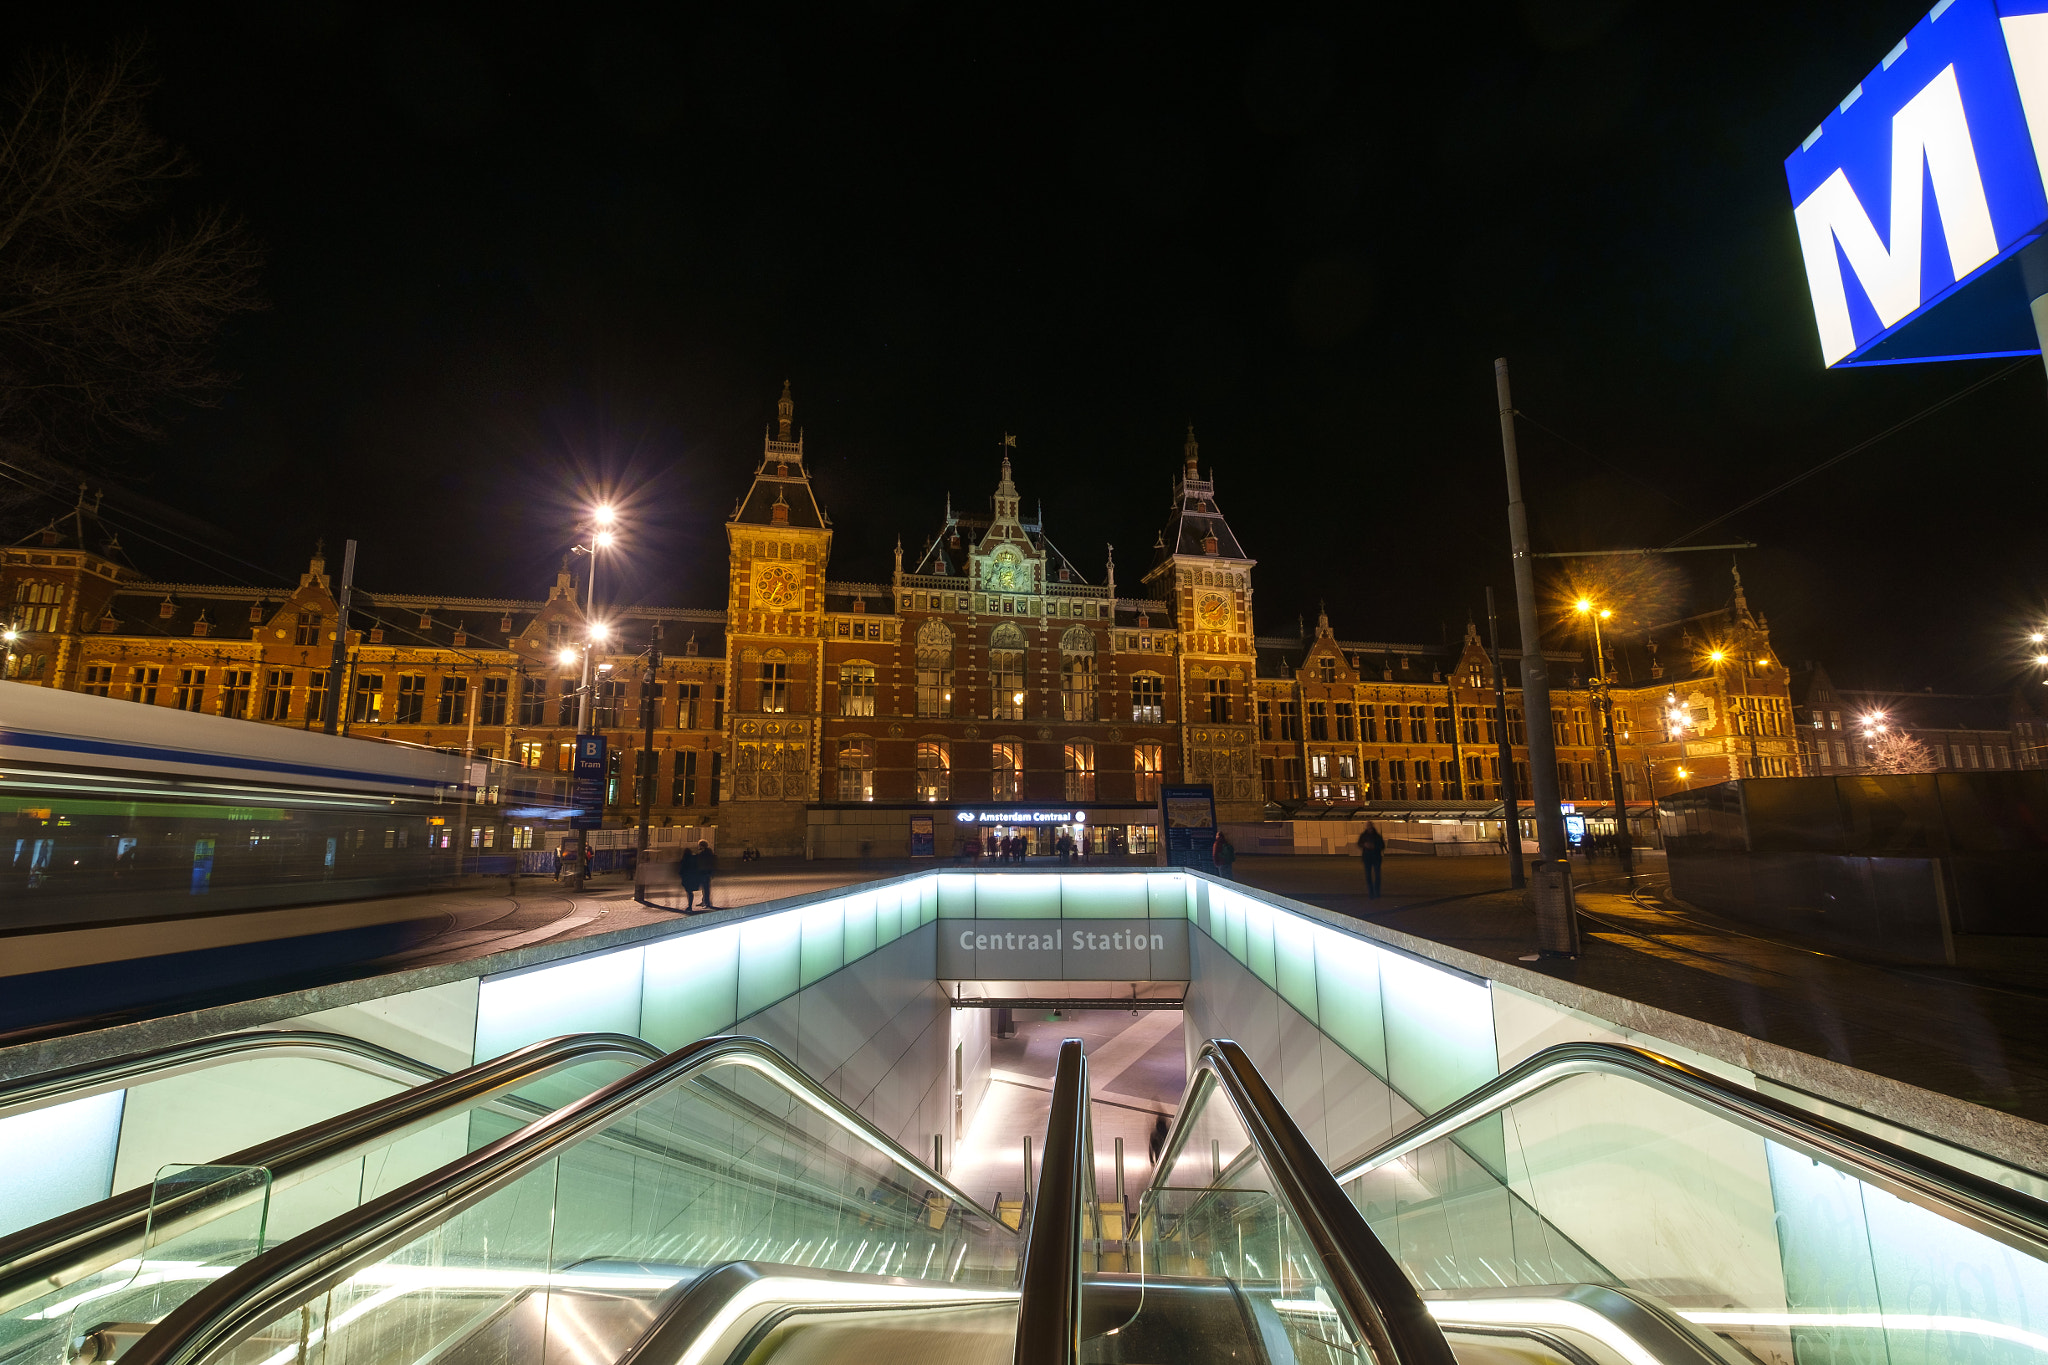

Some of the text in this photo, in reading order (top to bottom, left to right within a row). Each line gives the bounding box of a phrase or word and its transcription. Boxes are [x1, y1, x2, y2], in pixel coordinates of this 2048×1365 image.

[1794, 62, 2000, 369] M
[586, 742, 597, 756] B
[979, 812, 1071, 822] Amsterdam Centraal
[959, 928, 1165, 951] Centraal Station
